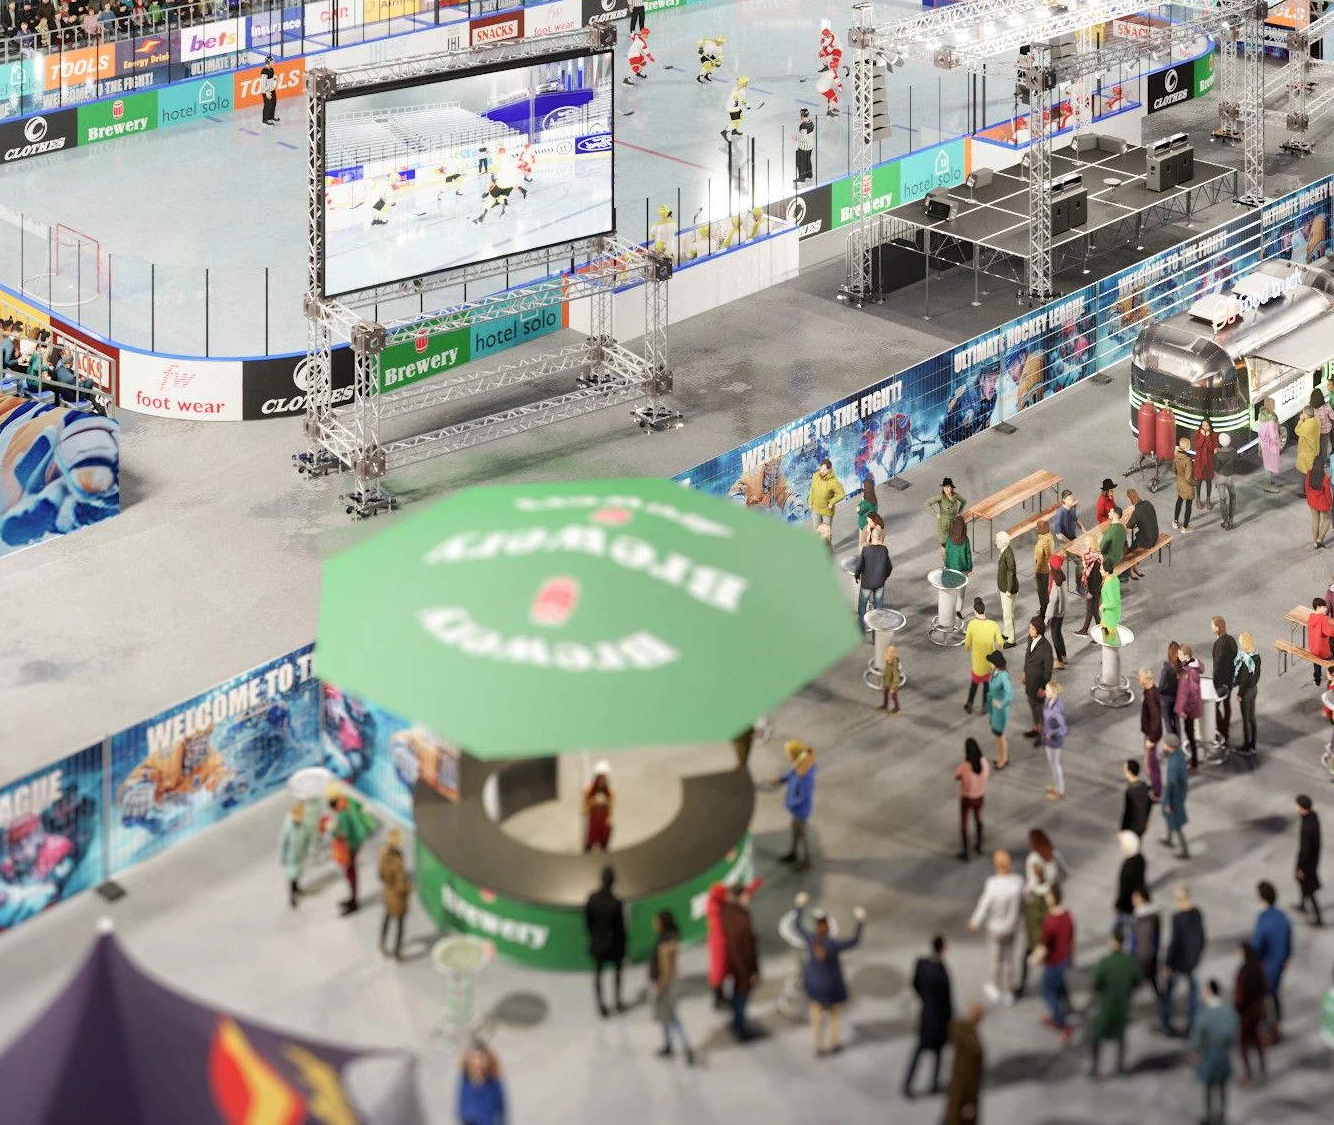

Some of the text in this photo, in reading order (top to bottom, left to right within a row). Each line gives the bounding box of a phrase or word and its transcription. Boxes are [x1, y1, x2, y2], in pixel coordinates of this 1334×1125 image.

[320, 7, 349, 23] CAR
[589, 8, 628, 25] CLOTHES
[190, 31, 236, 53] bets
[476, 24, 514, 41] SNACKS
[533, 21, 575, 39] foot wear
[51, 55, 109, 80] TOOLS
[124, 53, 169, 69] Energy Drink
[105, 79, 121, 95] THE
[123, 73, 153, 91] FIGHT!
[162, 97, 230, 122] hotel solo
[1154, 89, 1188, 110] CLOTHES
[88, 116, 148, 141] Brewery
[4, 136, 66, 161] CLOTHES
[905, 168, 961, 198] hotel solo
[475, 311, 557, 353] hotel solo
[384, 347, 459, 388] Brewery
[741, 295, 1085, 474] WELCOME TO THE FIGHT! ULTIMATE HOCKEY LEAGUE
[136, 390, 225, 414] foot wear
[147, 688, 265, 753] WELCOME
[266, 661, 295, 699] TO
